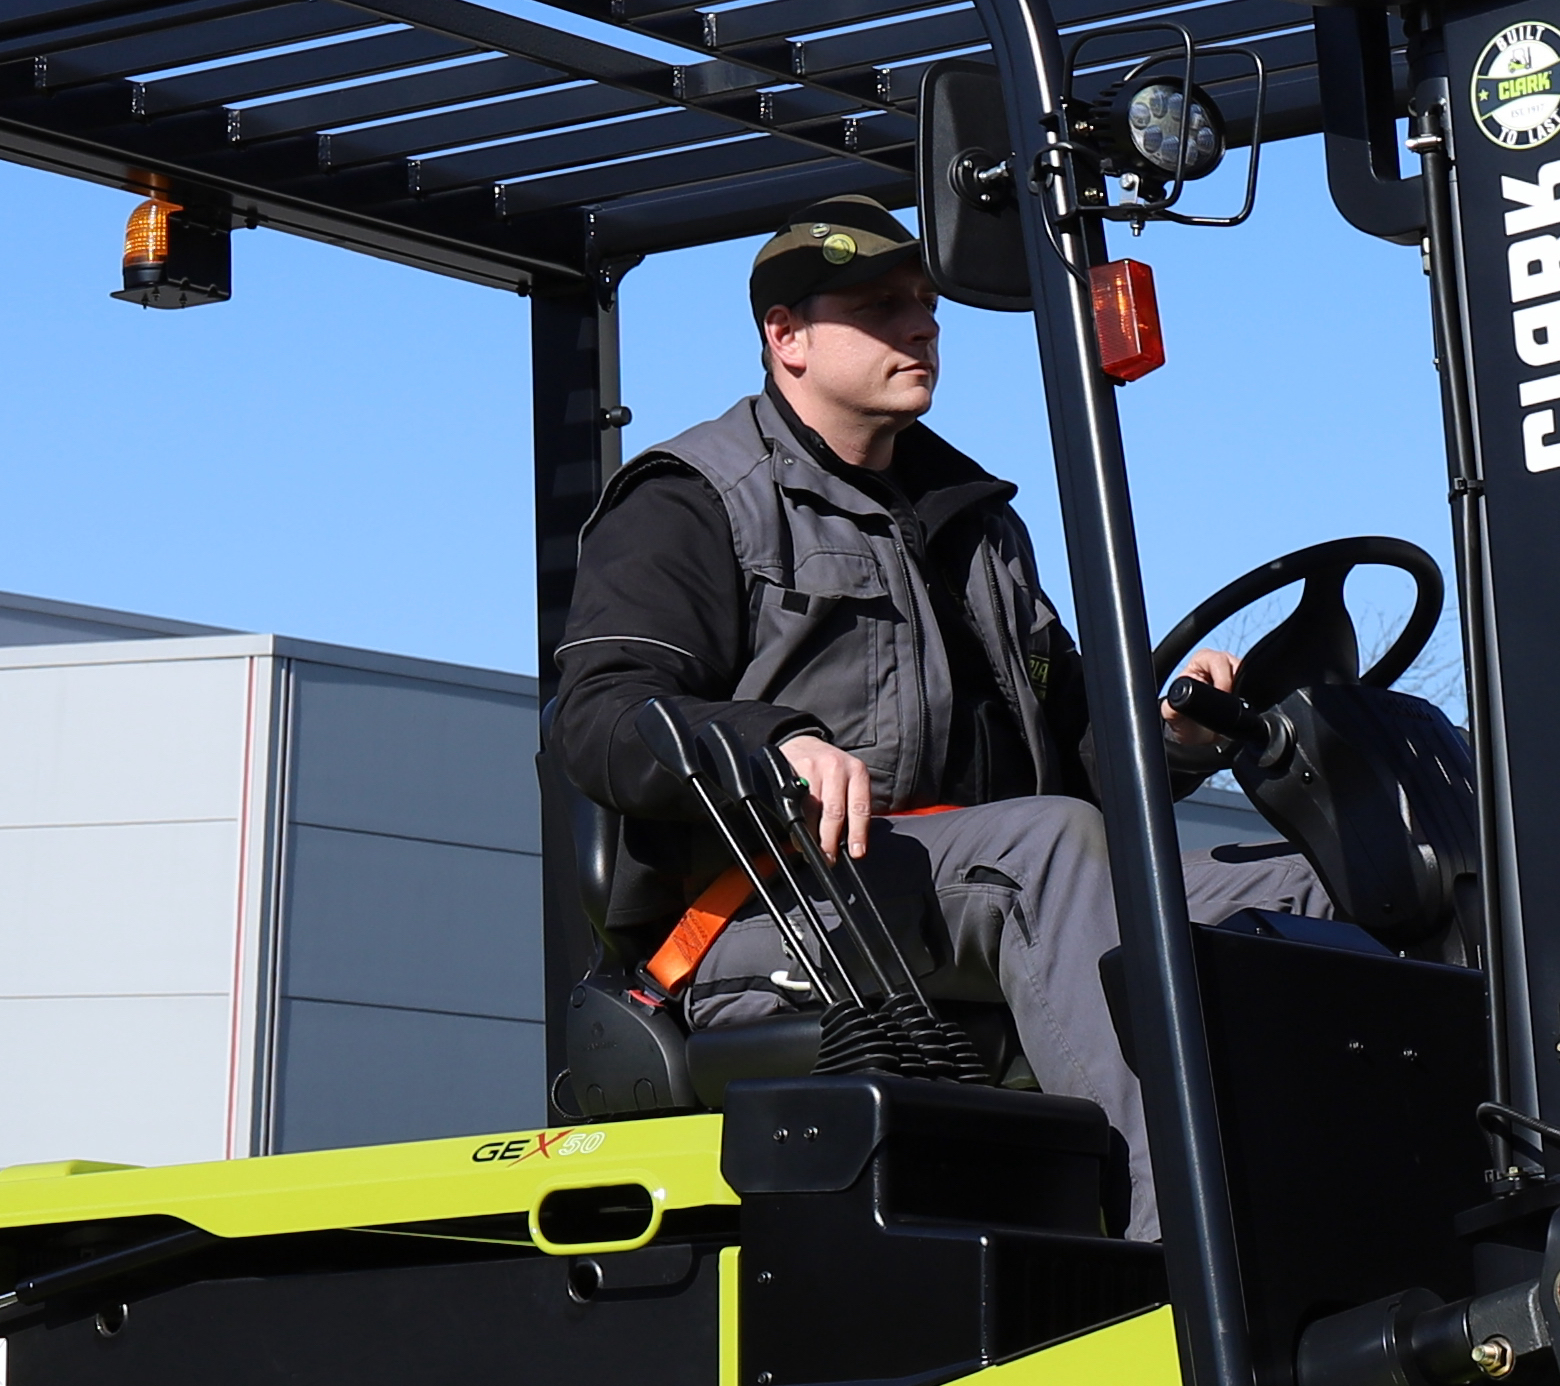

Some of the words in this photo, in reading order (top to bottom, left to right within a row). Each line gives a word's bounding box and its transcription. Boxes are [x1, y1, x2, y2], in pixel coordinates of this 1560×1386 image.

[1495, 24, 1546, 53] BUILT
[1498, 72, 1551, 100] CLARK
[1499, 126, 1519, 146] TO
